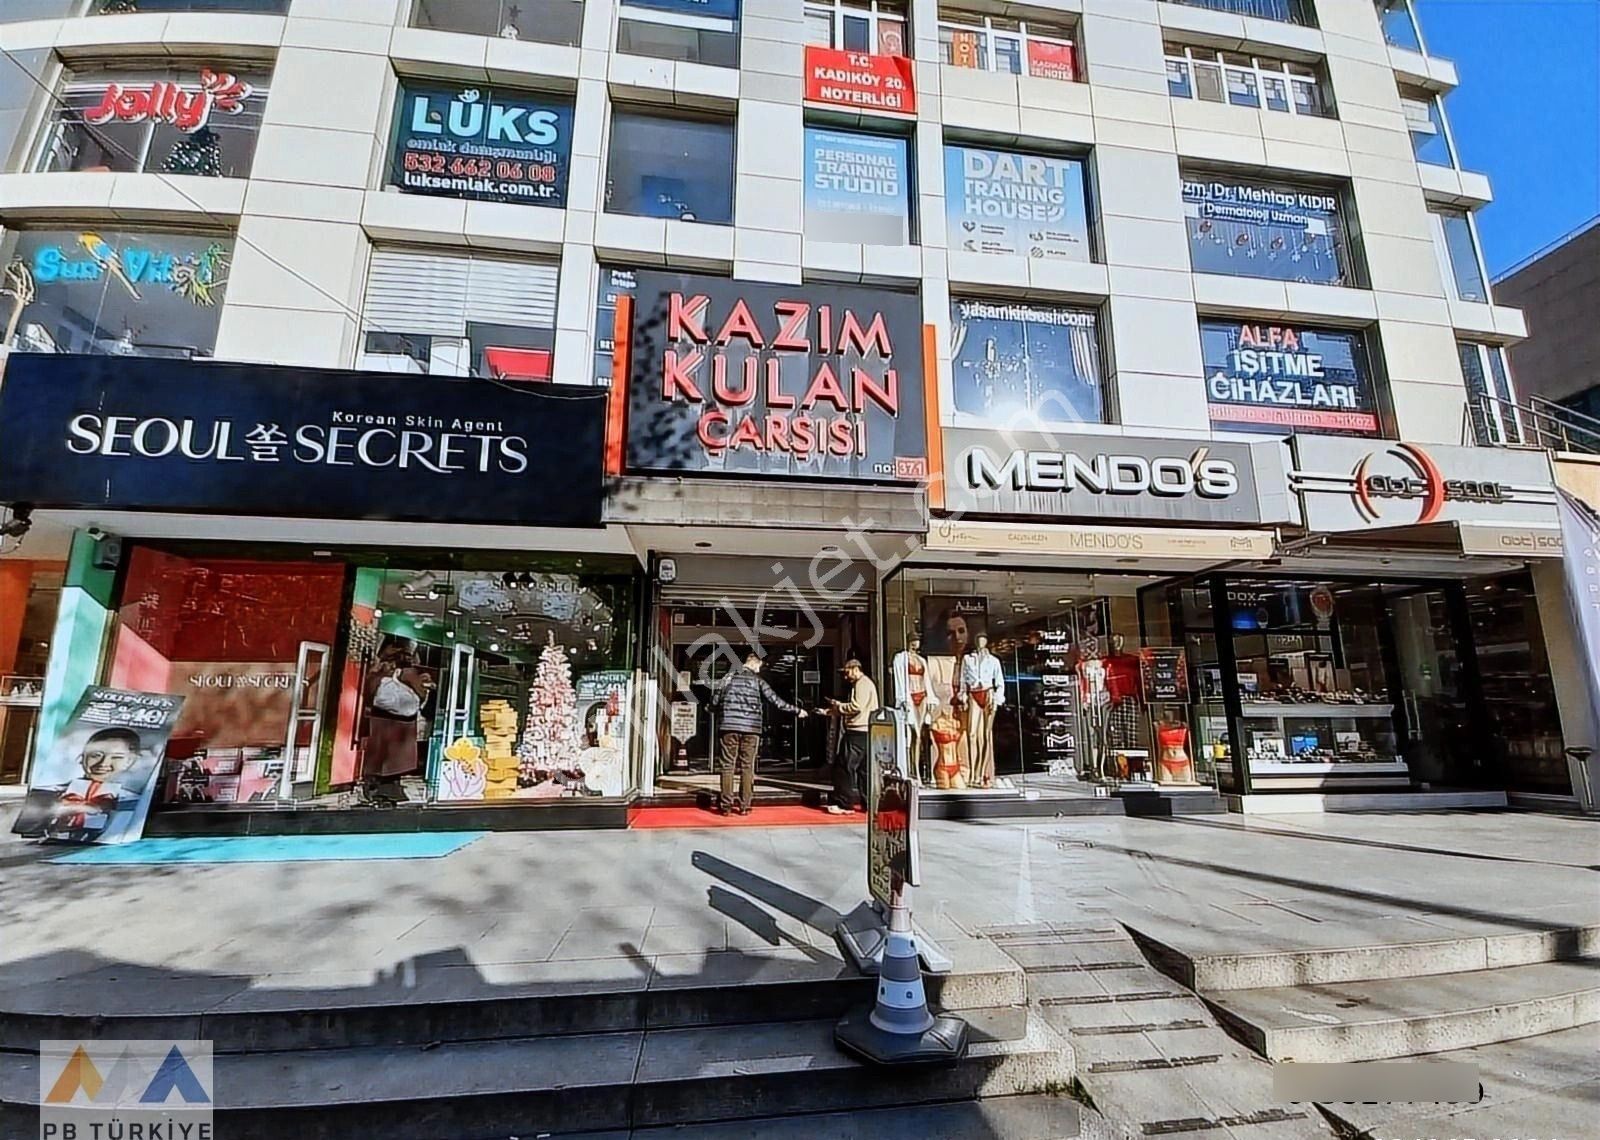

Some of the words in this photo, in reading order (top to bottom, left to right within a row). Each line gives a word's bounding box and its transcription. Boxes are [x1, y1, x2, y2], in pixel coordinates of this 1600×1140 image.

[847, 54, 873, 68] T.C.
[814, 66, 881, 87] KADIKÖY
[885, 77, 906, 90] 20.
[84, 81, 214, 132] Jolly
[404, 152, 446, 174] 532
[450, 157, 491, 178] 662
[497, 161, 523, 180] 06
[528, 164, 556, 182] 08
[814, 148, 897, 168] PERSONAL
[814, 160, 897, 180] TRAINING
[963, 149, 1070, 188] DART
[404, 171, 555, 198] luksemlak.com.tr
[814, 173, 899, 196] STUDIO
[963, 180, 1065, 205] TRAINING
[1239, 186, 1295, 207] Mehtap
[1298, 193, 1336, 211] KIDIR
[1206, 204, 1269, 221] Dermatoloji
[1271, 210, 1309, 225] Uzman
[668, 292, 893, 358] KAZIM
[1239, 325, 1299, 350] ALFA
[662, 350, 900, 418] KULAN
[332, 410, 396, 426] Korean
[405, 415, 443, 428] Skin
[451, 418, 503, 432] Agent
[66, 413, 245, 459] SEOUL
[293, 424, 528, 474] SECRETS
[697, 409, 868, 462] ÇARŞISI
[872, 463, 896, 474] no:
[899, 461, 922, 475] 371
[968, 447, 1239, 498] MENDO'S
[1070, 533, 1143, 550] MENDO'S
